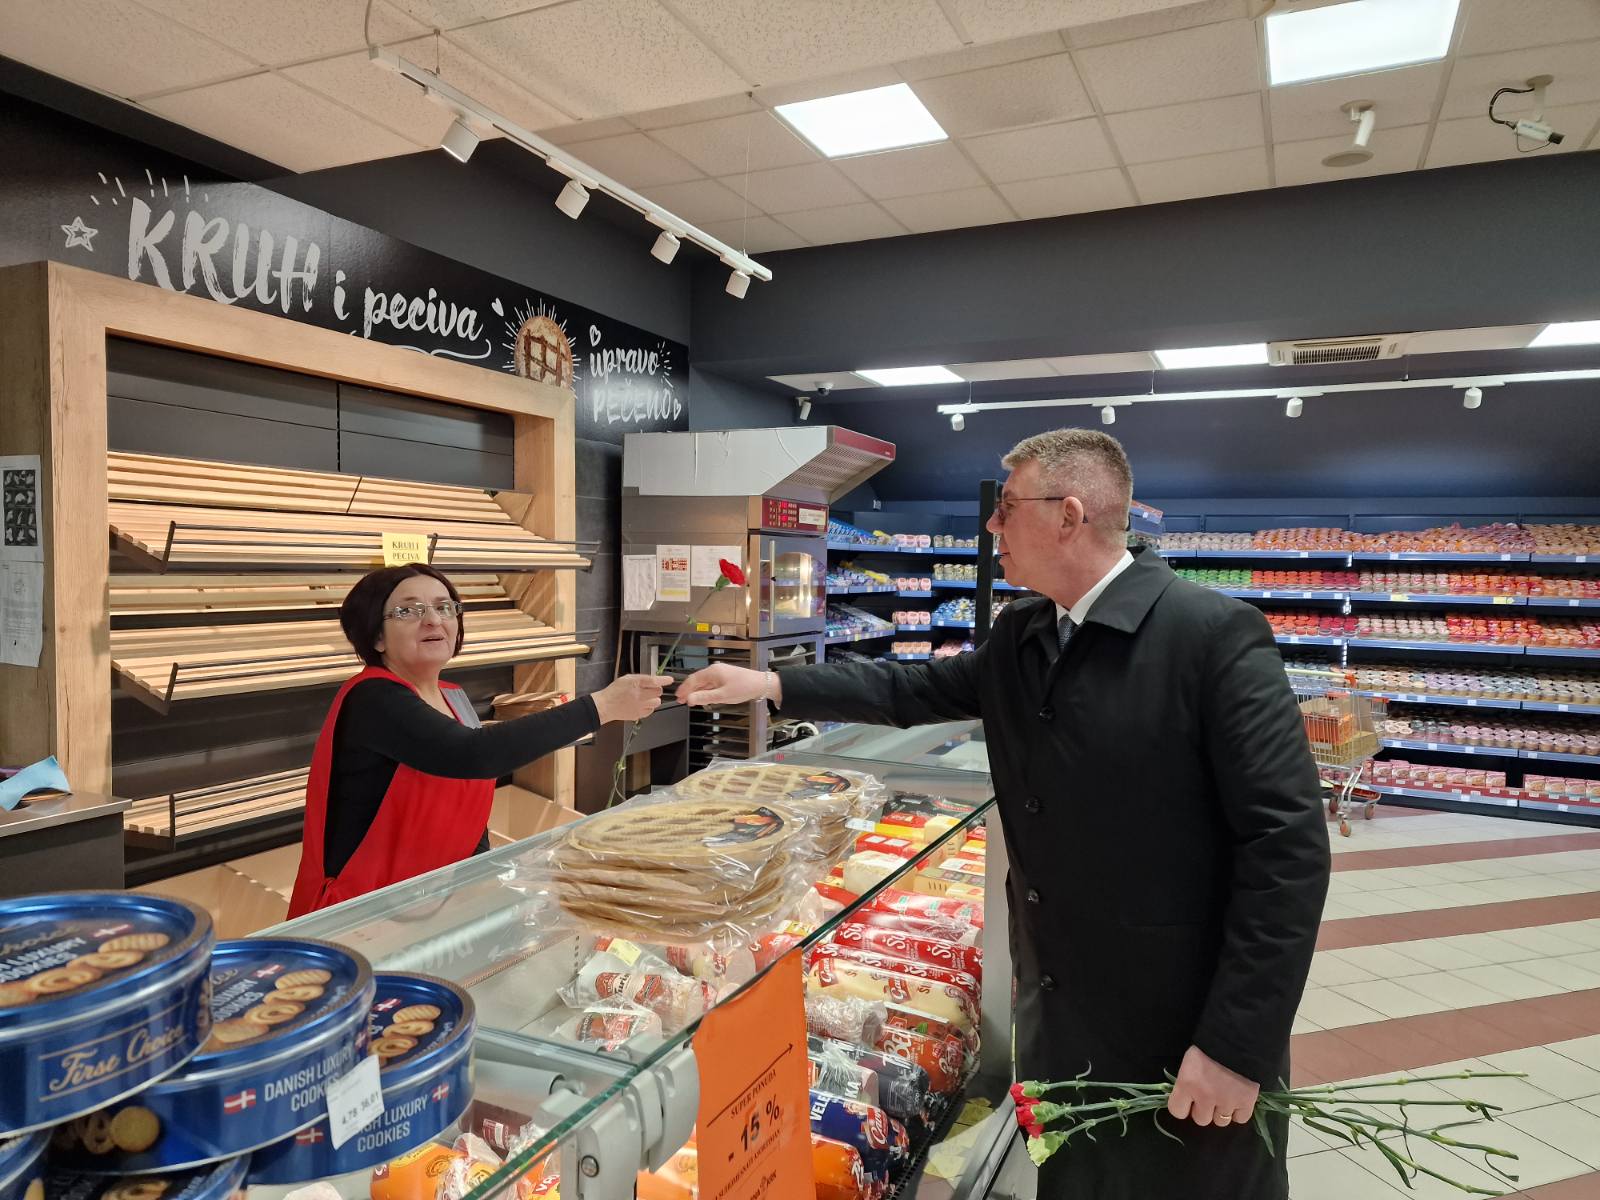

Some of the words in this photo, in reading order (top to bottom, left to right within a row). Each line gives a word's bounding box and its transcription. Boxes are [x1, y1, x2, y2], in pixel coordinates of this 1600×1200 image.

[128, 197, 320, 314] KRUH
[333, 270, 349, 320] i
[363, 287, 485, 342] peciva
[589, 347, 660, 385] upravo
[593, 378, 671, 425] PEČENO
[392, 541, 415, 549] KRUH
[392, 552, 420, 561] PECIVA
[49, 1048, 120, 1091] First
[126, 1024, 184, 1063] Choice
[264, 1066, 315, 1102] DANISH
[317, 1044, 354, 1078] LUXURY
[384, 1094, 429, 1125] LUXURY
[357, 1121, 411, 1153] COOKIES
[741, 1111, 760, 1152] 15
